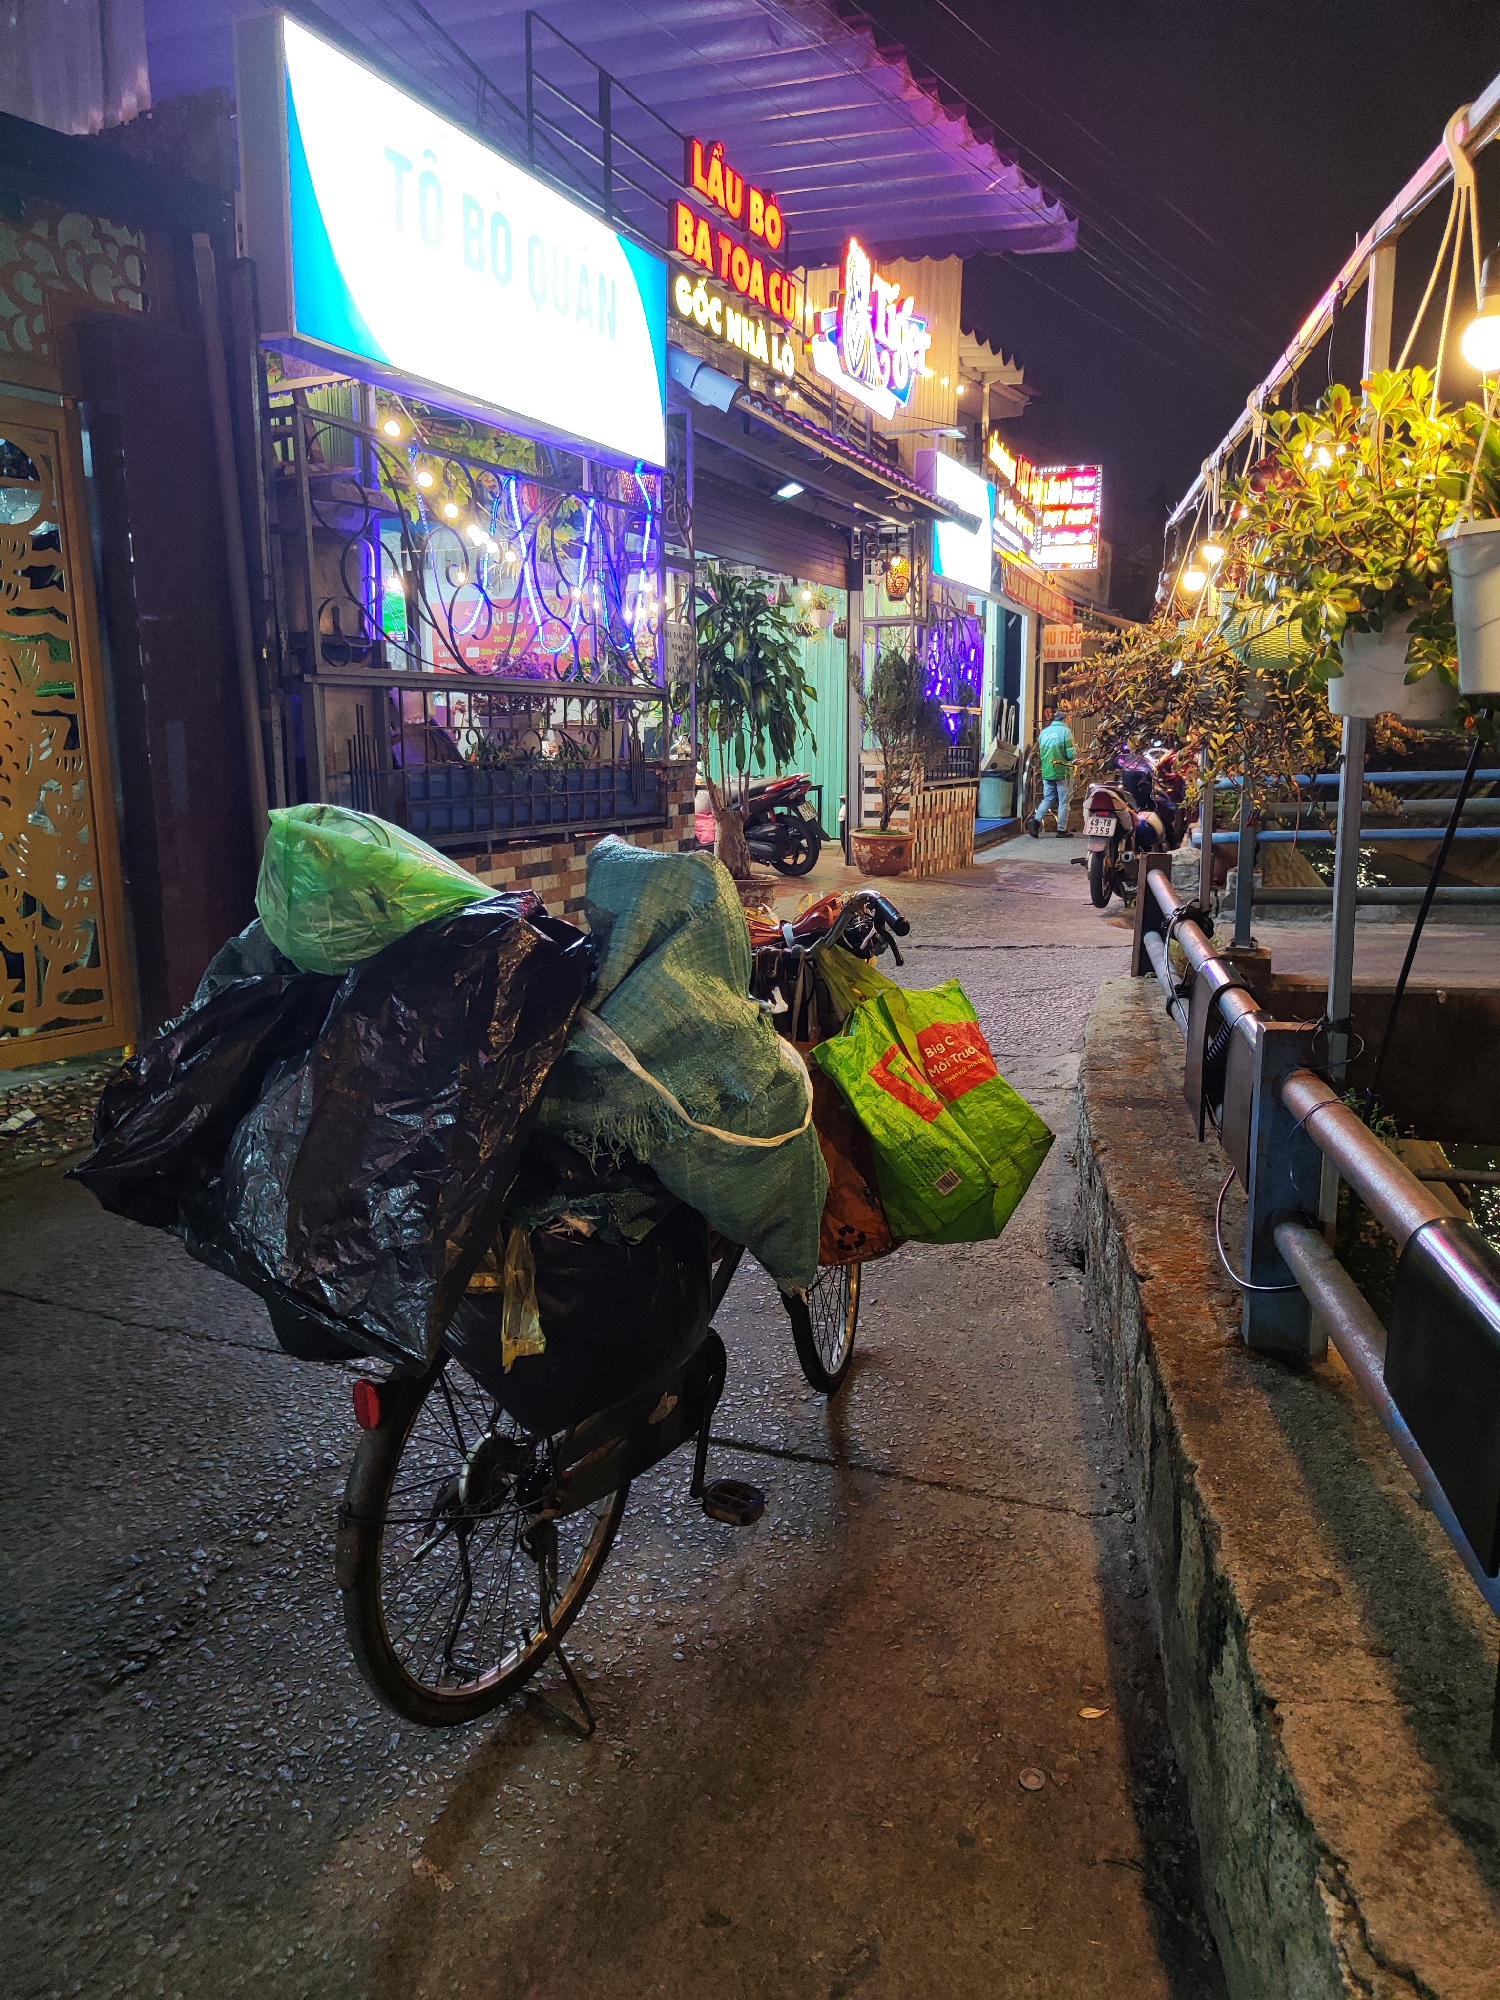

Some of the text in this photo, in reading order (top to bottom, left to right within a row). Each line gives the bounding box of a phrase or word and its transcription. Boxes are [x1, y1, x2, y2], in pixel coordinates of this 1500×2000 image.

[462, 190, 513, 288] BÒ
[692, 138, 783, 250] LẨU BÒ
[675, 201, 714, 272] BA
[717, 230, 767, 307] TOA
[675, 276, 796, 380] GỐC NHÀ LÒ
[924, 1036, 955, 1059] Big C
[926, 1058, 951, 1078] Môi
